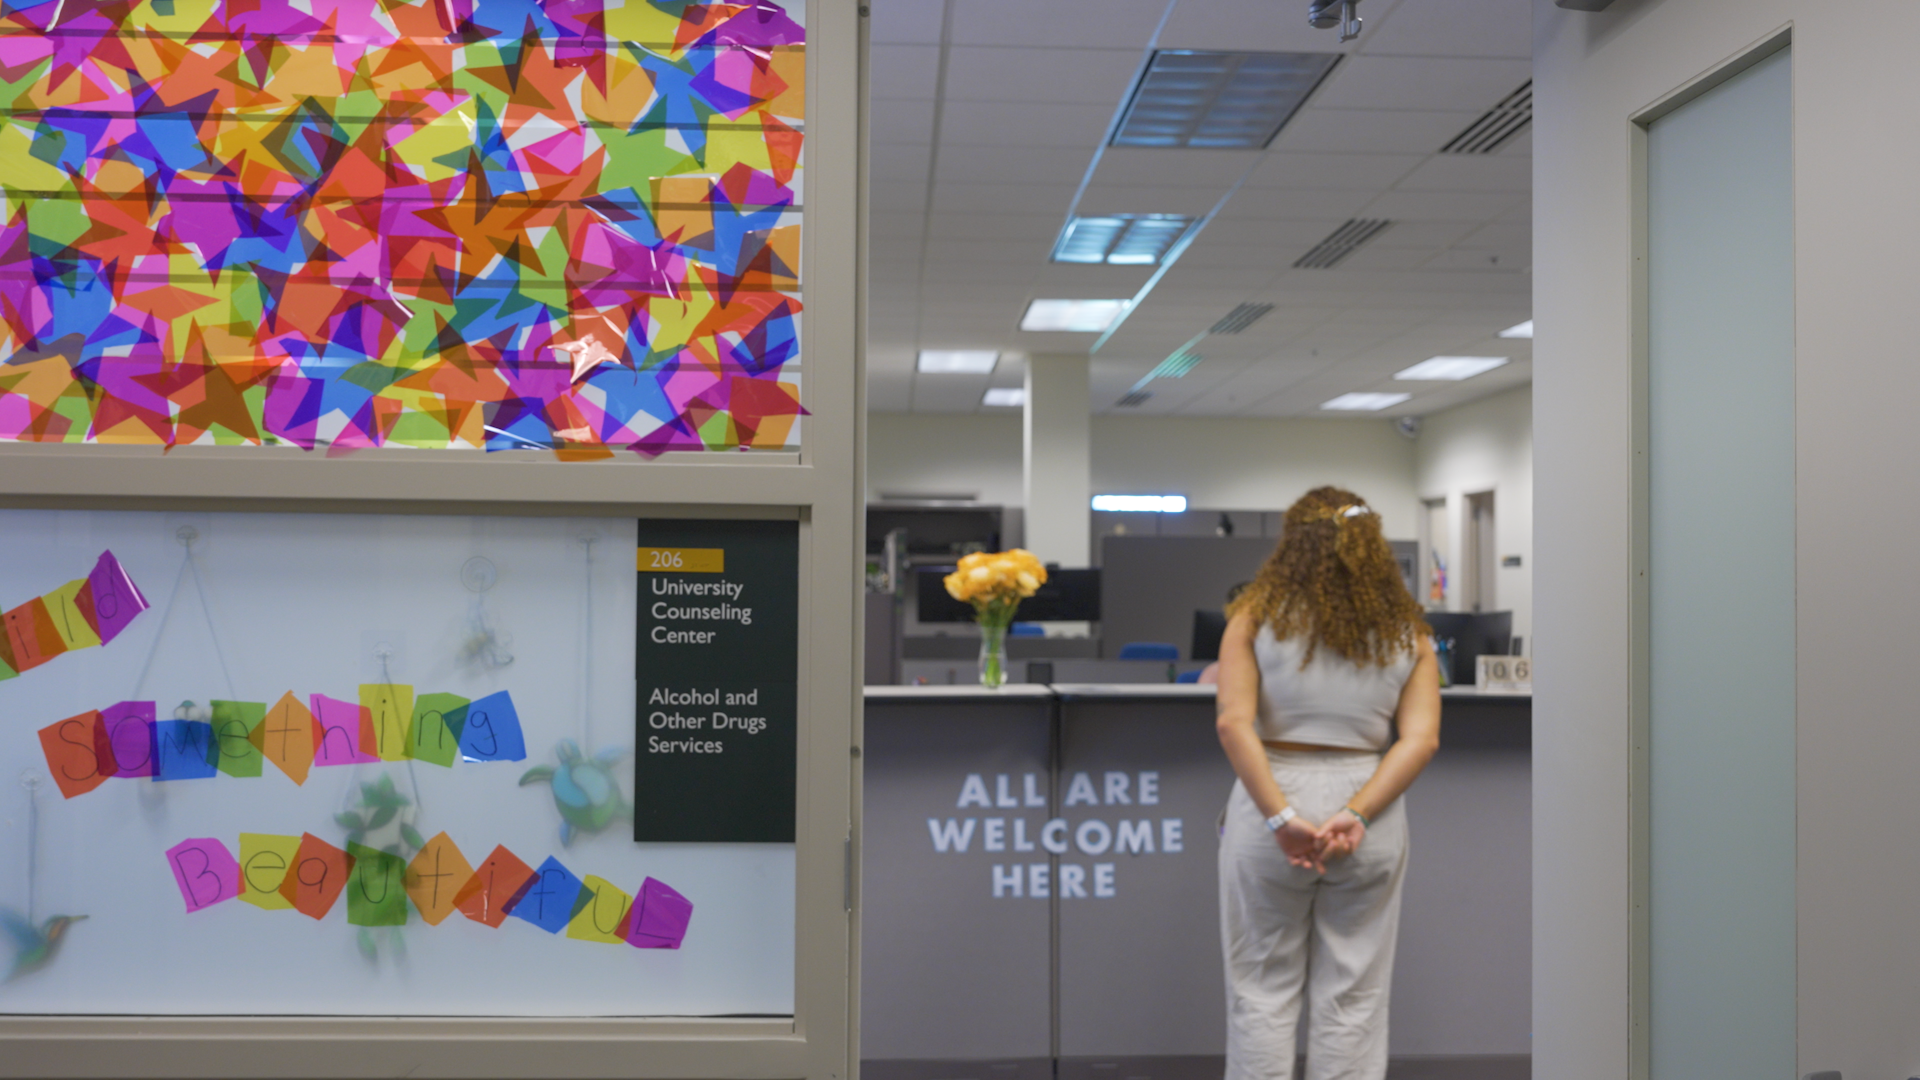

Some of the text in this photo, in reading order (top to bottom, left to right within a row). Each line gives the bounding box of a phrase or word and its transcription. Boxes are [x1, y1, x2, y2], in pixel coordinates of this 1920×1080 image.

[650, 551, 683, 568] 206
[651, 578, 744, 600] University
[651, 602, 752, 625] Counseling
[651, 626, 716, 644] Center
[649, 688, 758, 706] Alcohol and
[649, 711, 767, 734] Other Drugs
[648, 736, 723, 753] Services
[956, 771, 1160, 808] ALL ARE
[927, 818, 1184, 855] WELCOME
[992, 863, 1116, 898] HERE
